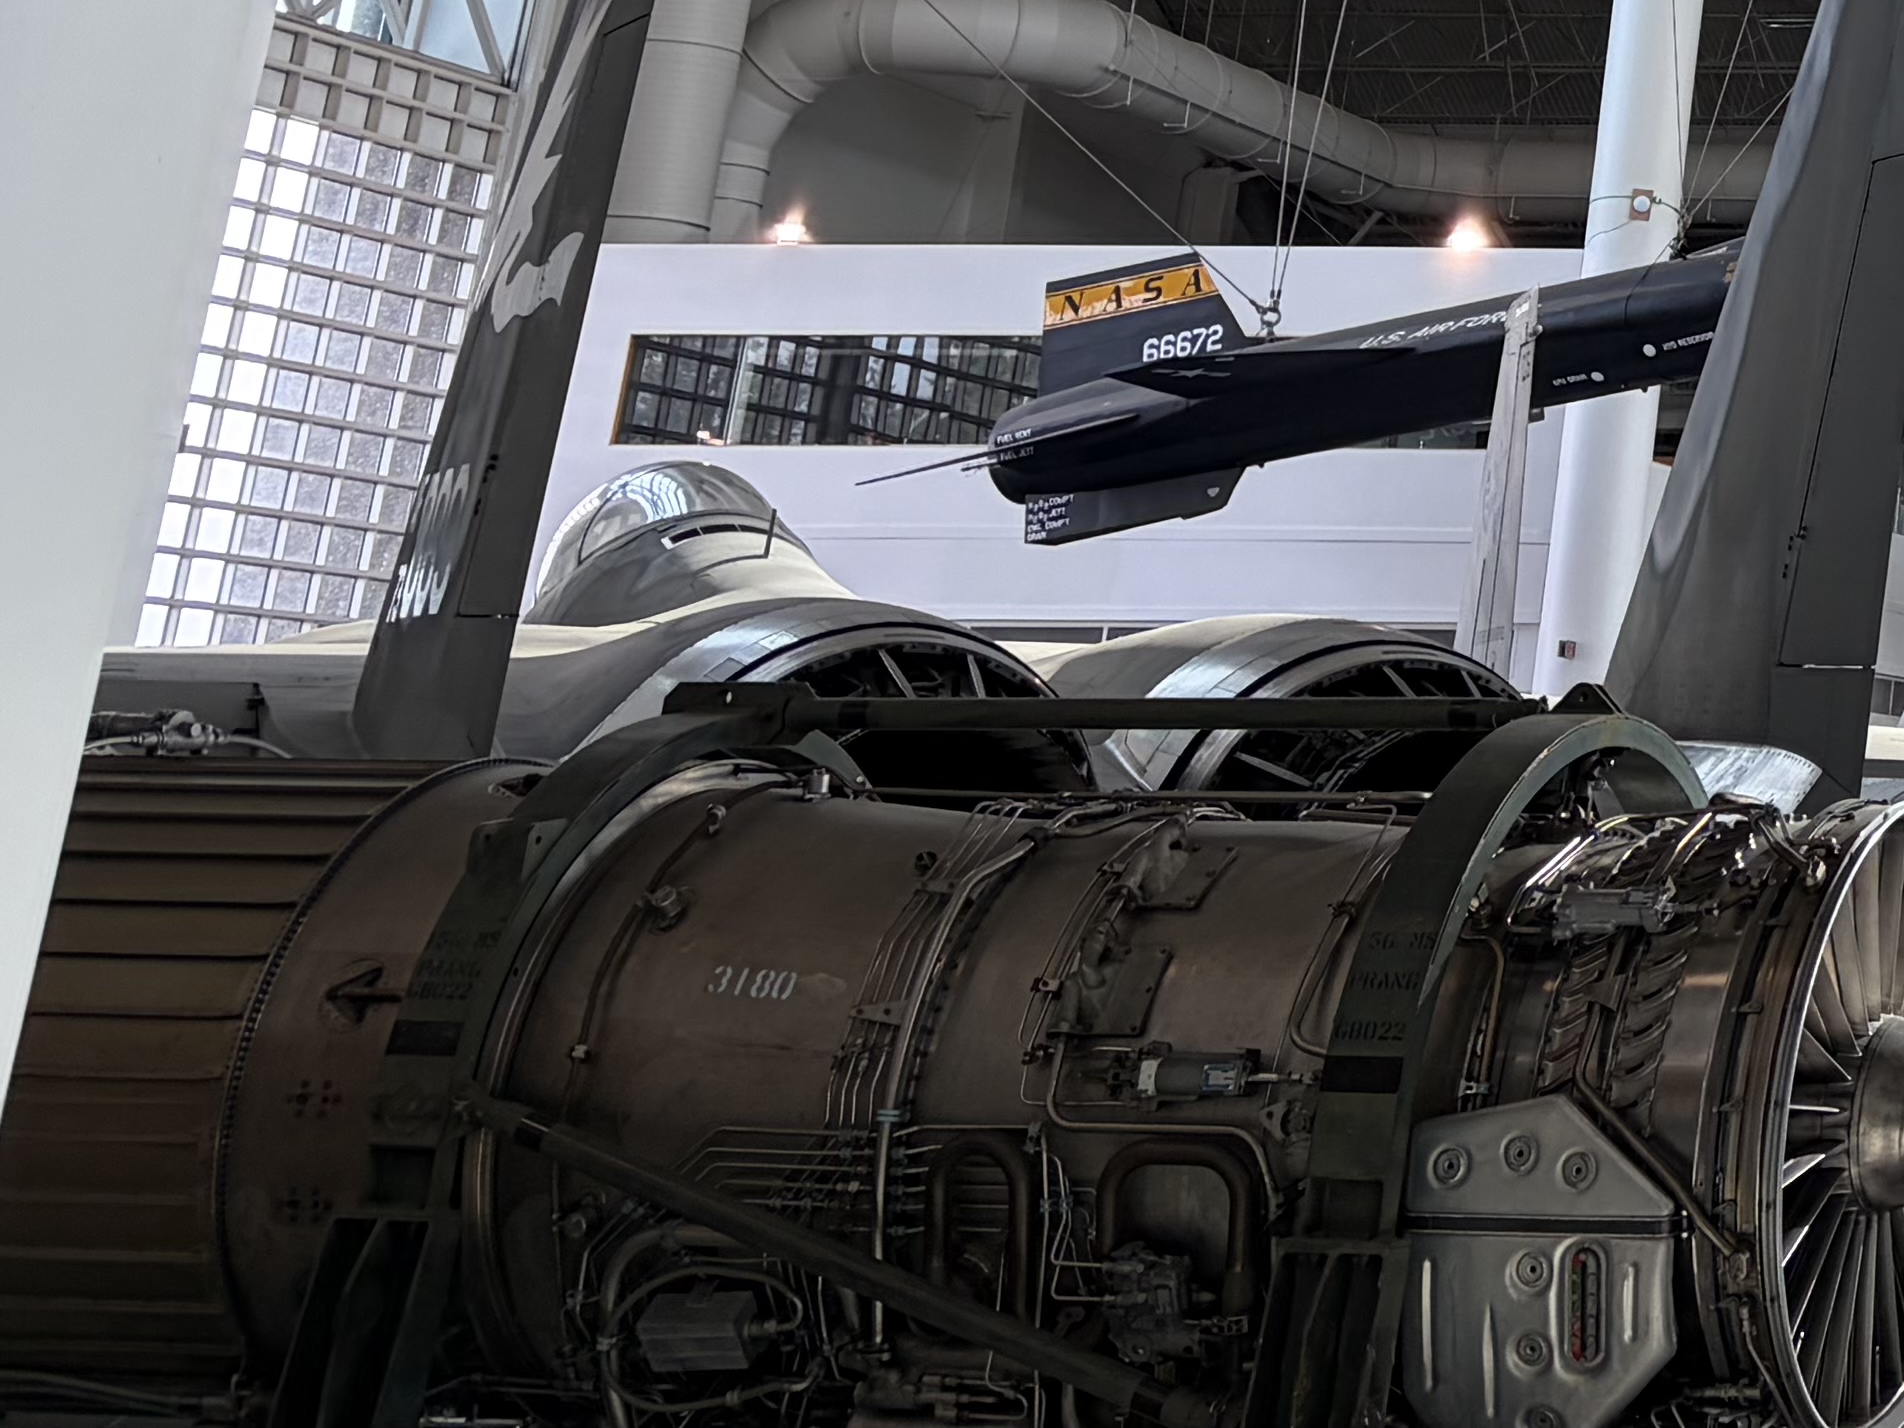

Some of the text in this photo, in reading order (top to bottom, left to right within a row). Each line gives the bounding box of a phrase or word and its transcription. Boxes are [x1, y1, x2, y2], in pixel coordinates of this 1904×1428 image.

[1059, 268, 1203, 321] NASA
[1142, 323, 1224, 363] 66672
[1408, 320, 1455, 340] AIR
[1450, 311, 1508, 332] FOR
[707, 965, 798, 1000] 3180
